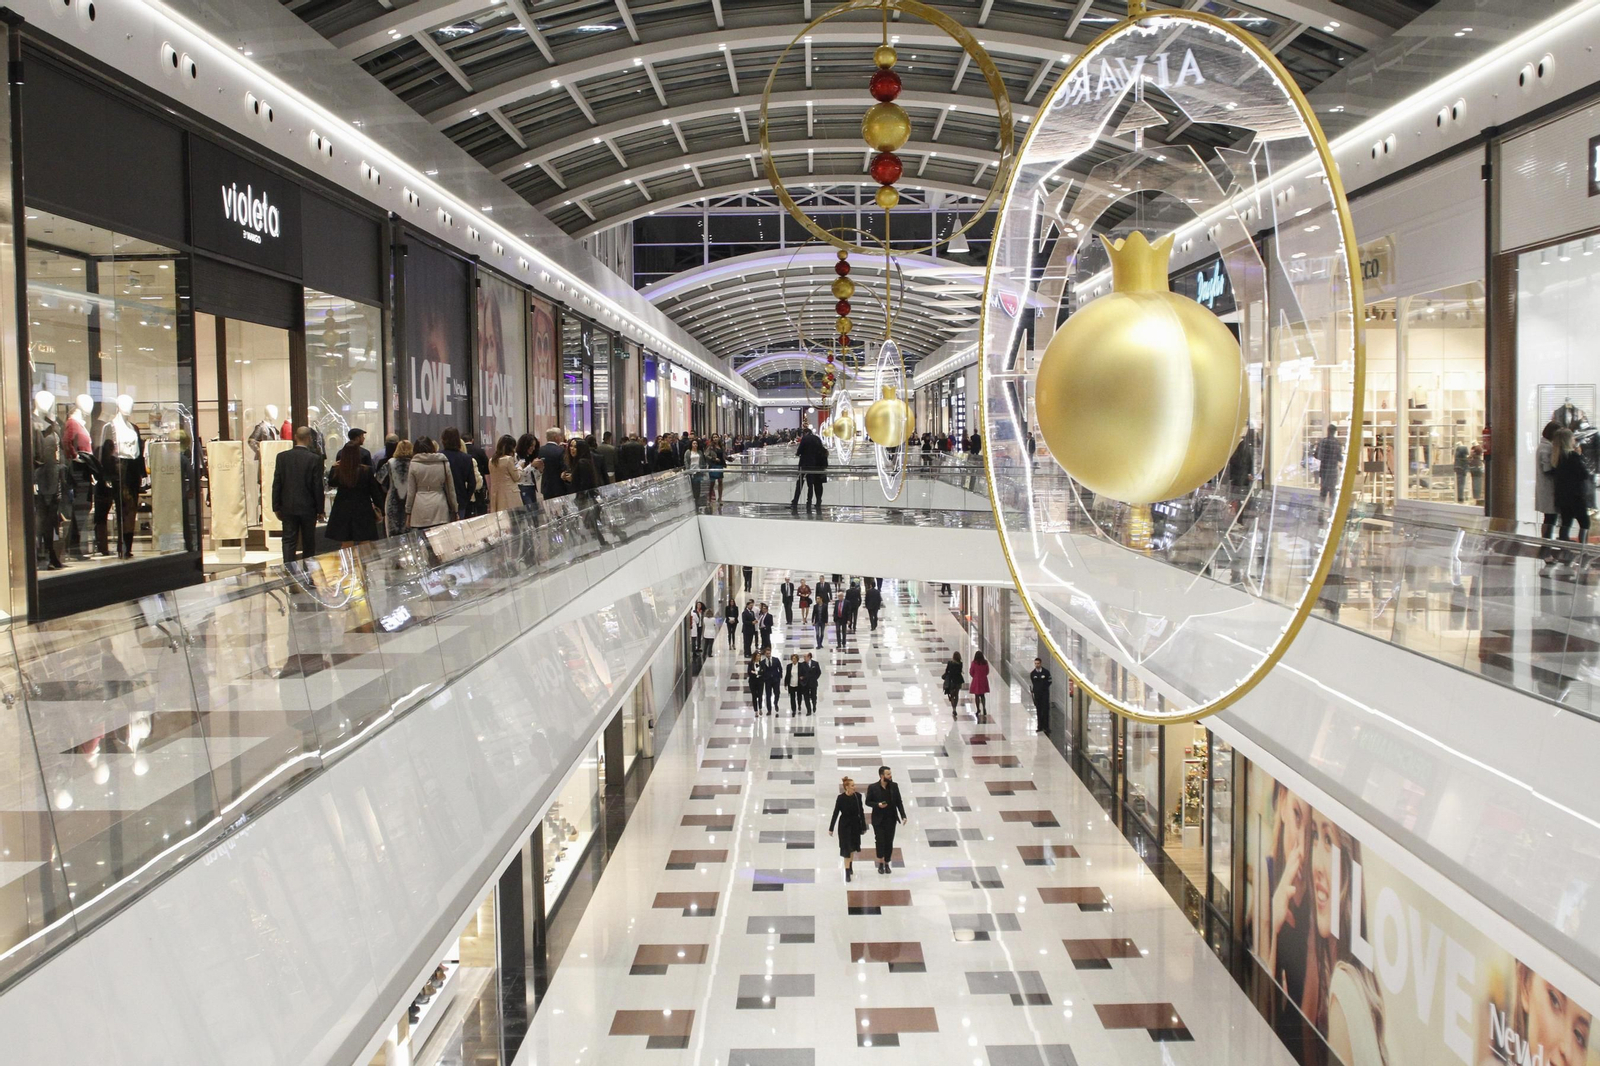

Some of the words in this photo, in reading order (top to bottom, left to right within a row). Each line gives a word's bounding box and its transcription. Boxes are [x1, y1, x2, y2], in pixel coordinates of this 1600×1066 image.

[221, 182, 280, 237] violeta
[410, 356, 453, 416] LOVE
[484, 370, 514, 419] LOVE
[534, 376, 557, 417] LOVE
[1330, 843, 1341, 940] I
[1350, 859, 1476, 1066] LOVE
